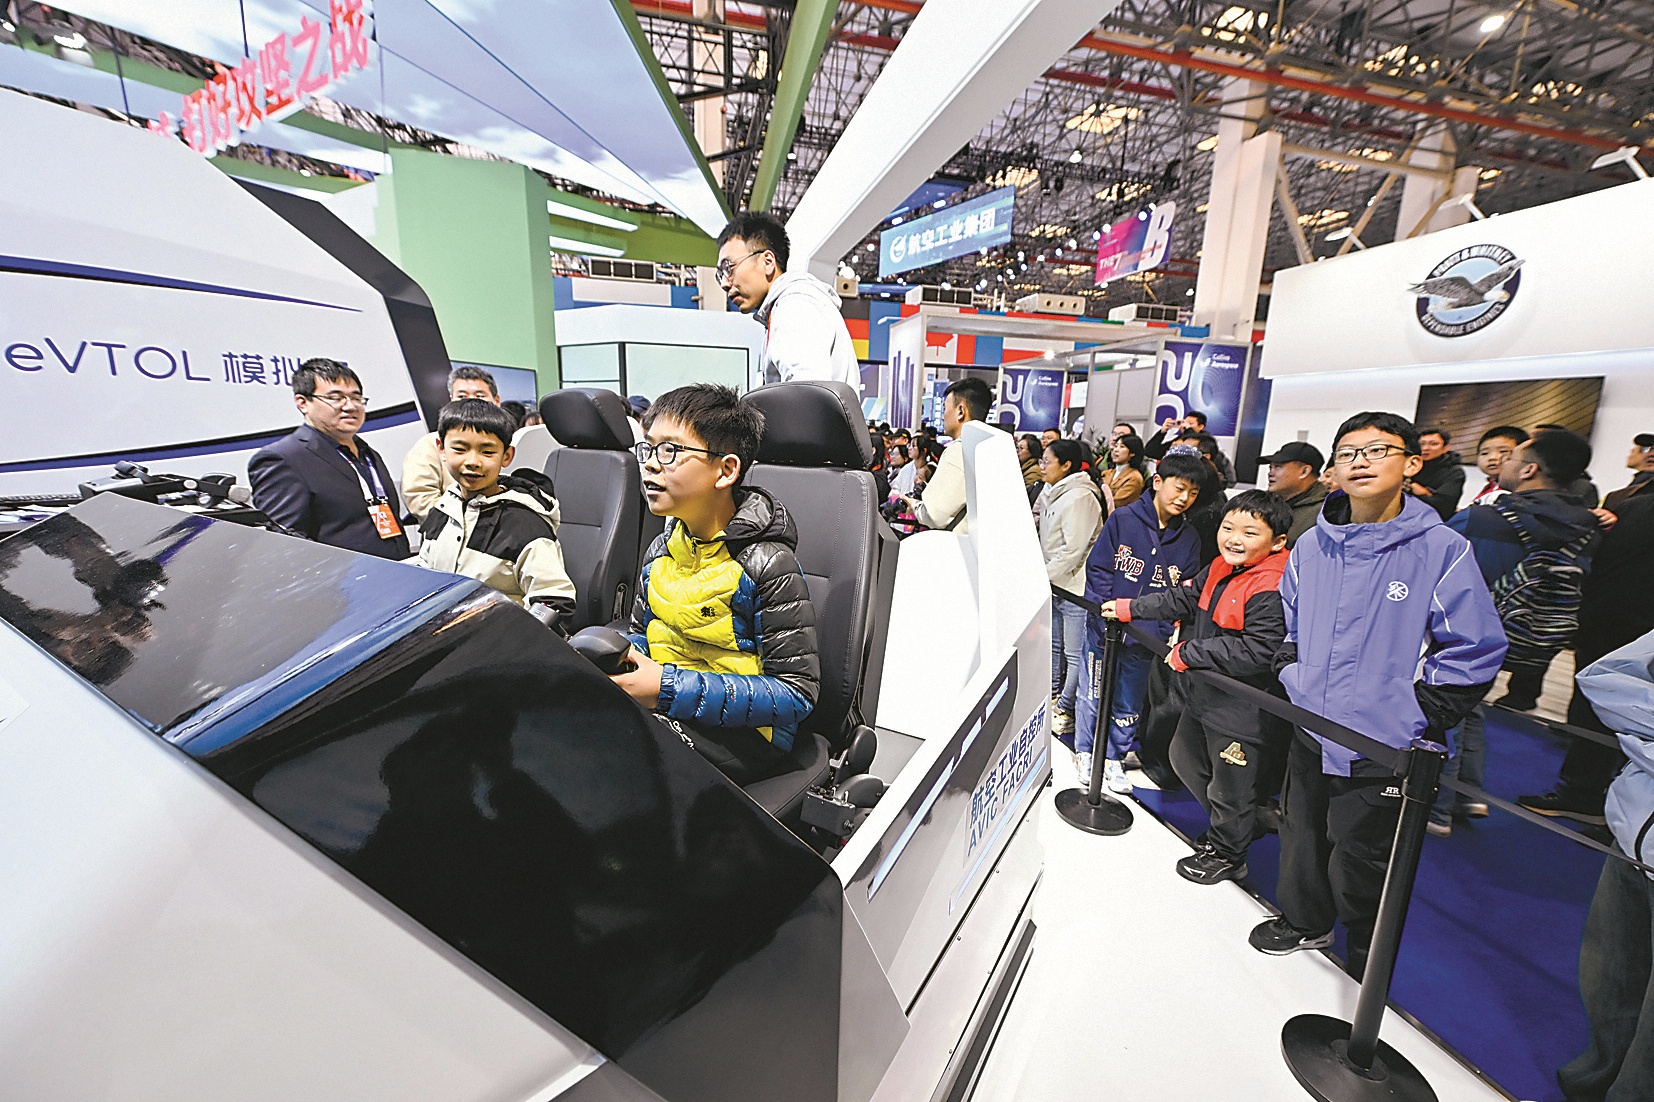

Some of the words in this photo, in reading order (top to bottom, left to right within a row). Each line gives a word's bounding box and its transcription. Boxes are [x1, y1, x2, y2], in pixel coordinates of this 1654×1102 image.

[147, 0, 368, 153] 打好攻坚之战
[908, 207, 996, 255] 航空工业集团
[5, 337, 211, 382] eVTOL
[967, 798, 998, 858] AVIC
[1002, 745, 1033, 805] FACRI
[969, 702, 1046, 829] 航空工业自控所
